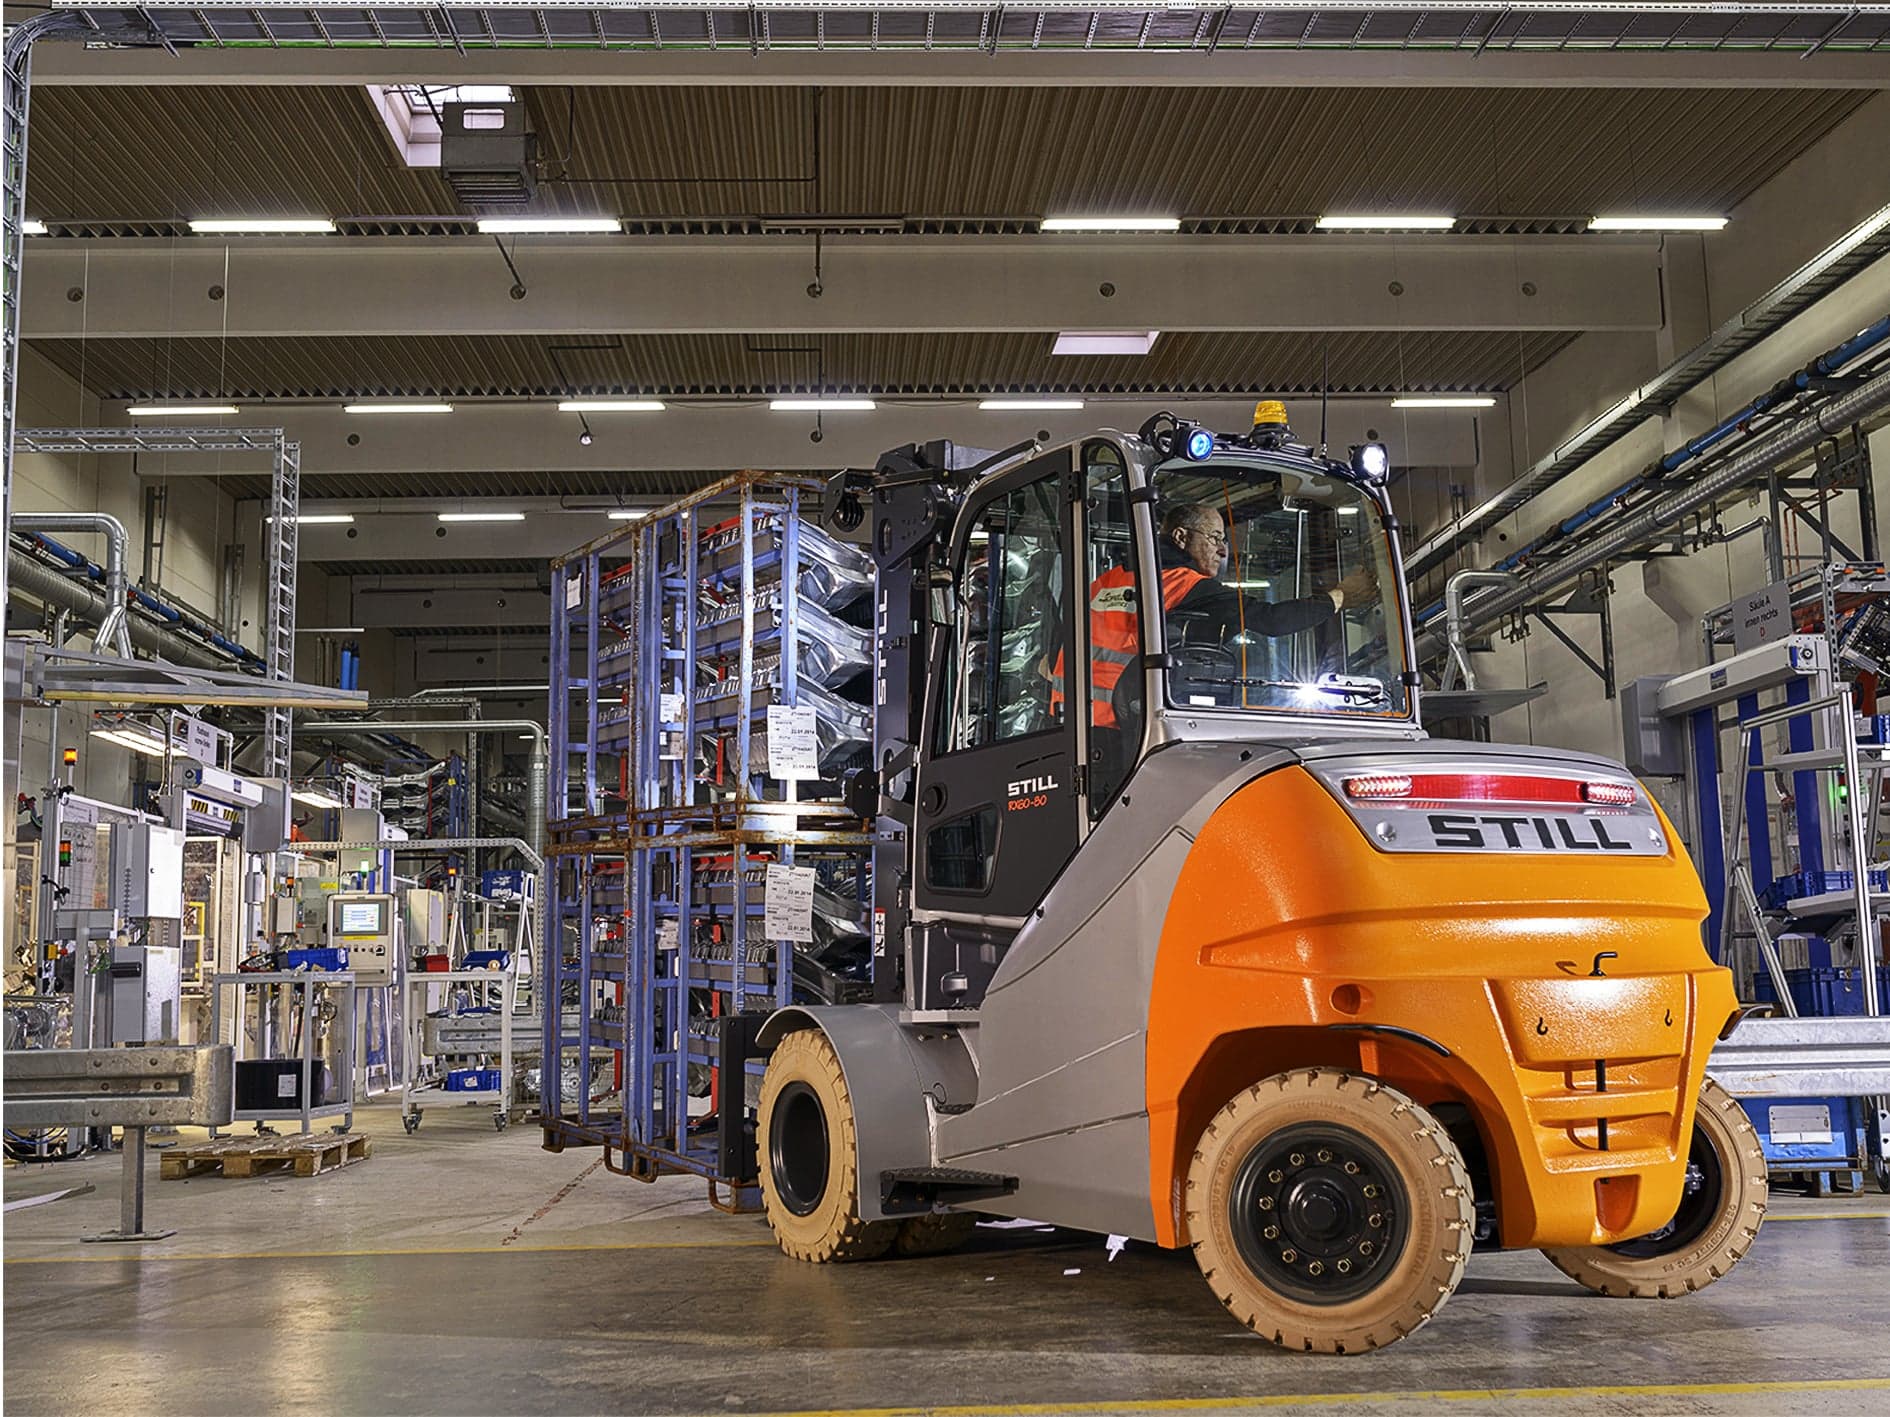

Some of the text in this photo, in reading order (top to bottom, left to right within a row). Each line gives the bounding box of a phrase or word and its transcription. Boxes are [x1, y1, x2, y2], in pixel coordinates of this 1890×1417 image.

[877, 589, 888, 706] STILL
[1008, 775, 1059, 797] STILL
[1427, 815, 1633, 850] STILL
